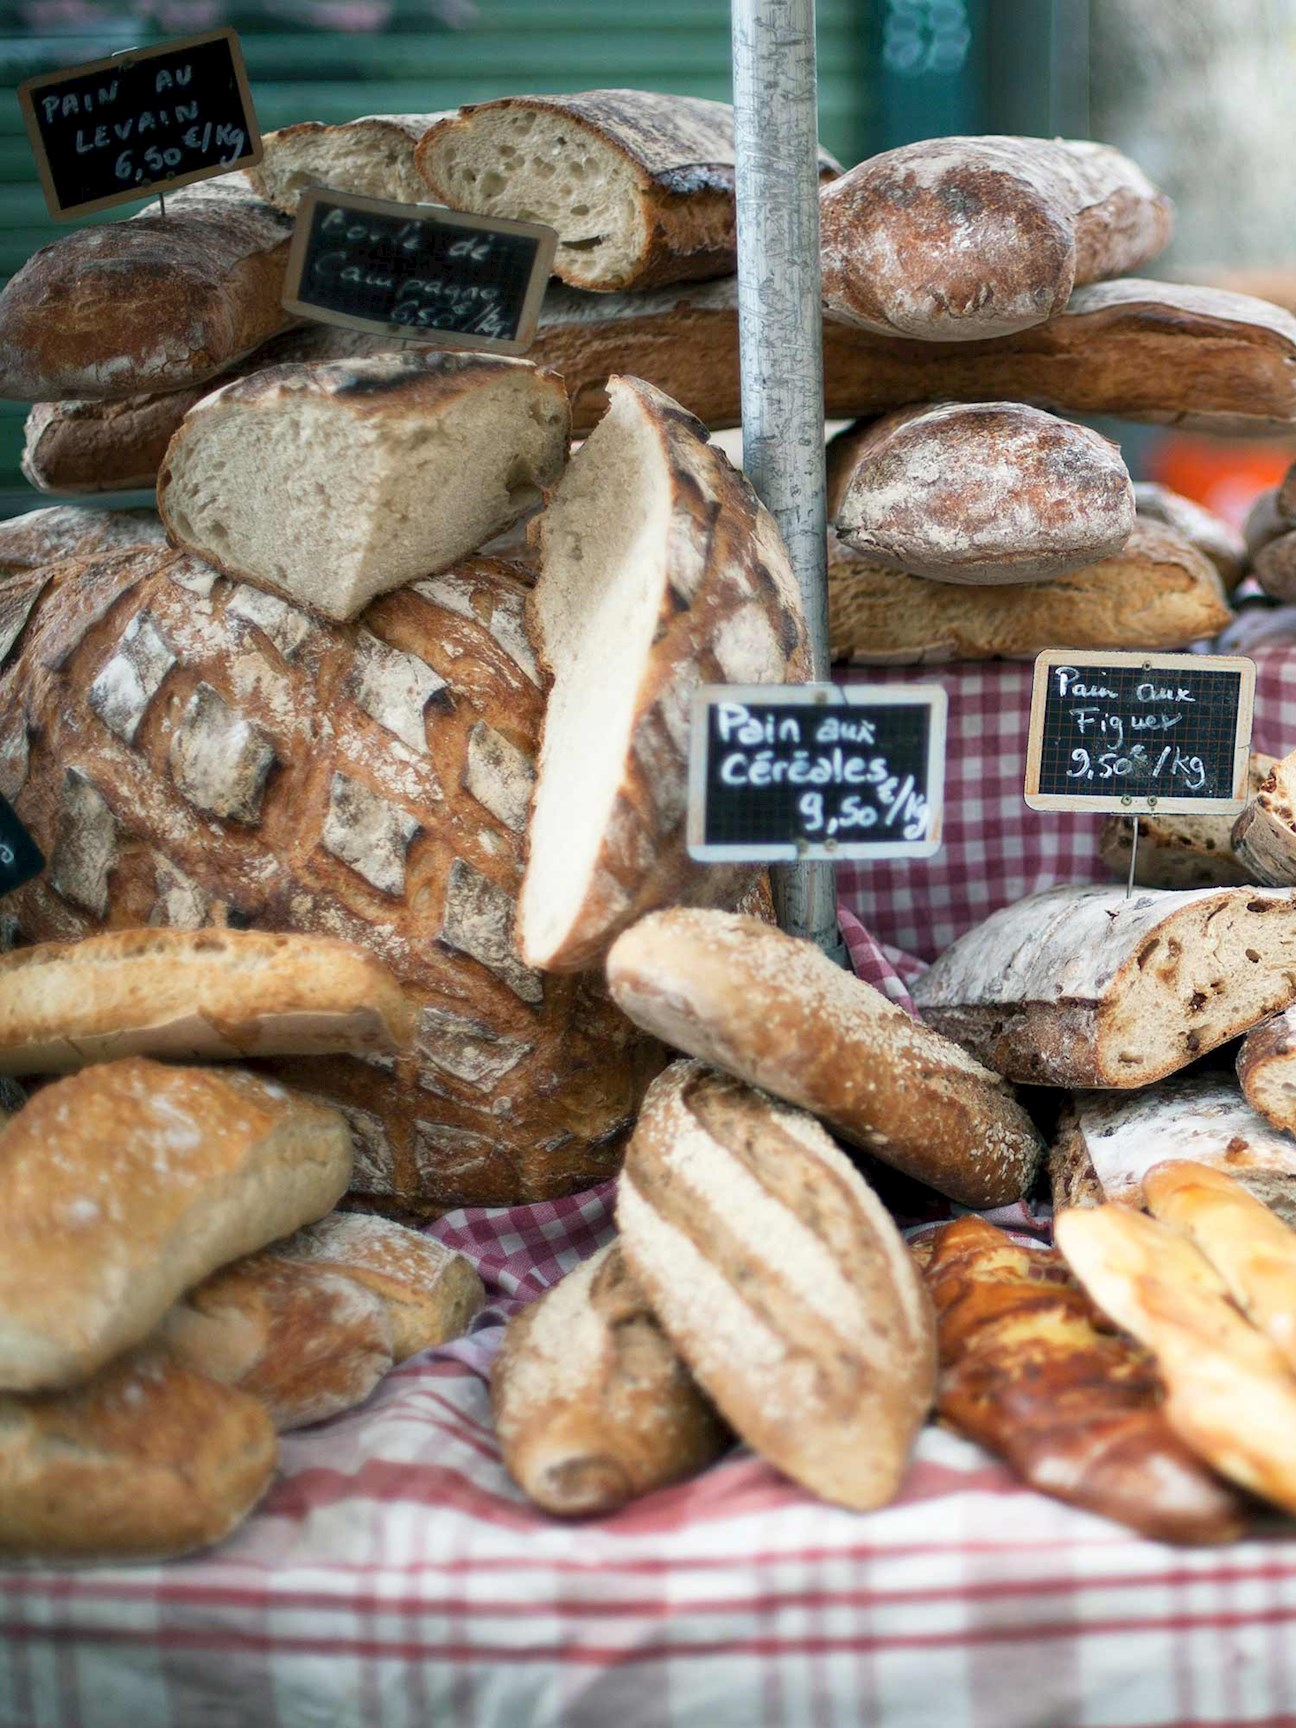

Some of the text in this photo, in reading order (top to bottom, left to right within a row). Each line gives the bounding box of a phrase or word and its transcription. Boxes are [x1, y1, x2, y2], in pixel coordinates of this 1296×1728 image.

[42, 65, 192, 123] PAIN AU
[76, 101, 199, 154] LEVAIN
[1054, 666, 1118, 698] Pain
[717, 702, 876, 745] Pain aux
[720, 747, 888, 785] Céréales
